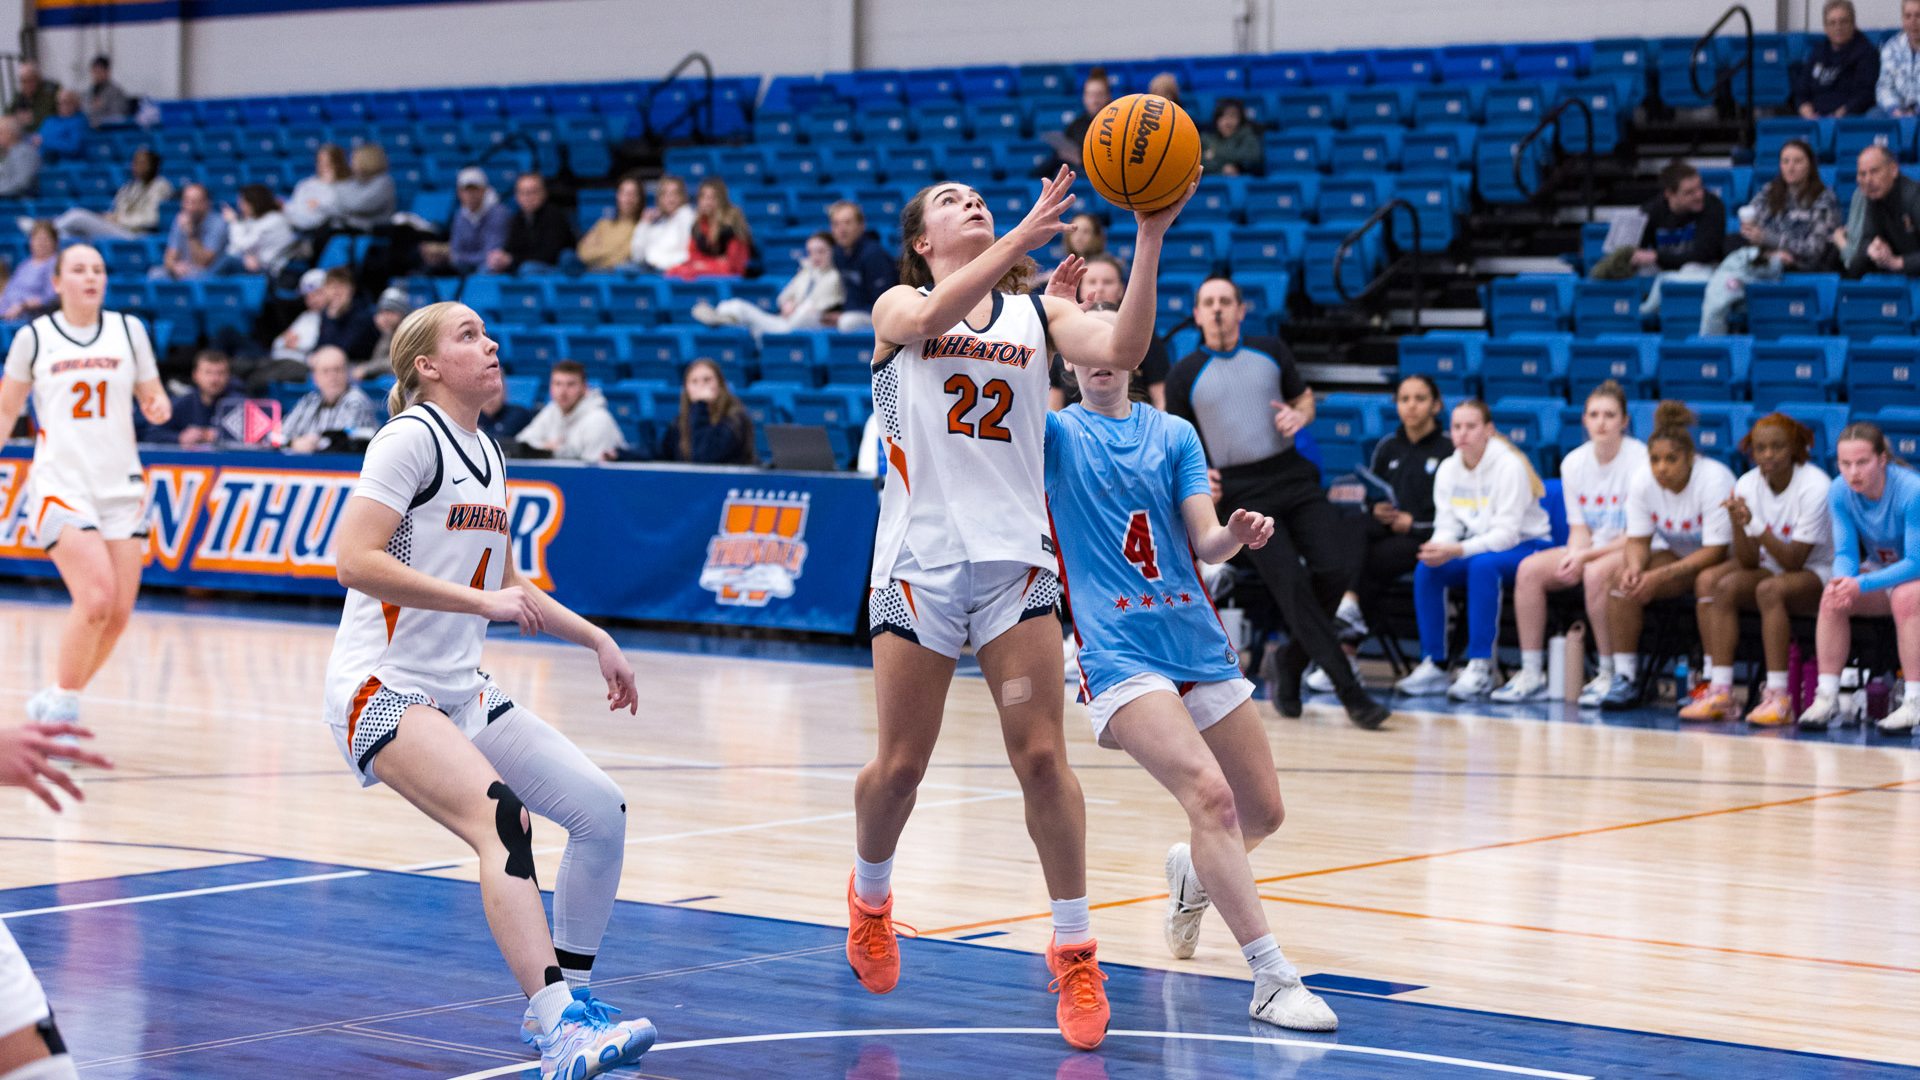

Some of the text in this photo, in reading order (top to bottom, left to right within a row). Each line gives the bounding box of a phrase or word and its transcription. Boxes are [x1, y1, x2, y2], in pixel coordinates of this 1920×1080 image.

[1129, 99, 1166, 165] Wilson
[922, 335, 1036, 369] WHEATON
[72, 381, 107, 419] 21
[944, 373, 1014, 443] 22
[446, 504, 508, 535] WHEATO
[1121, 509, 1163, 583] 4
